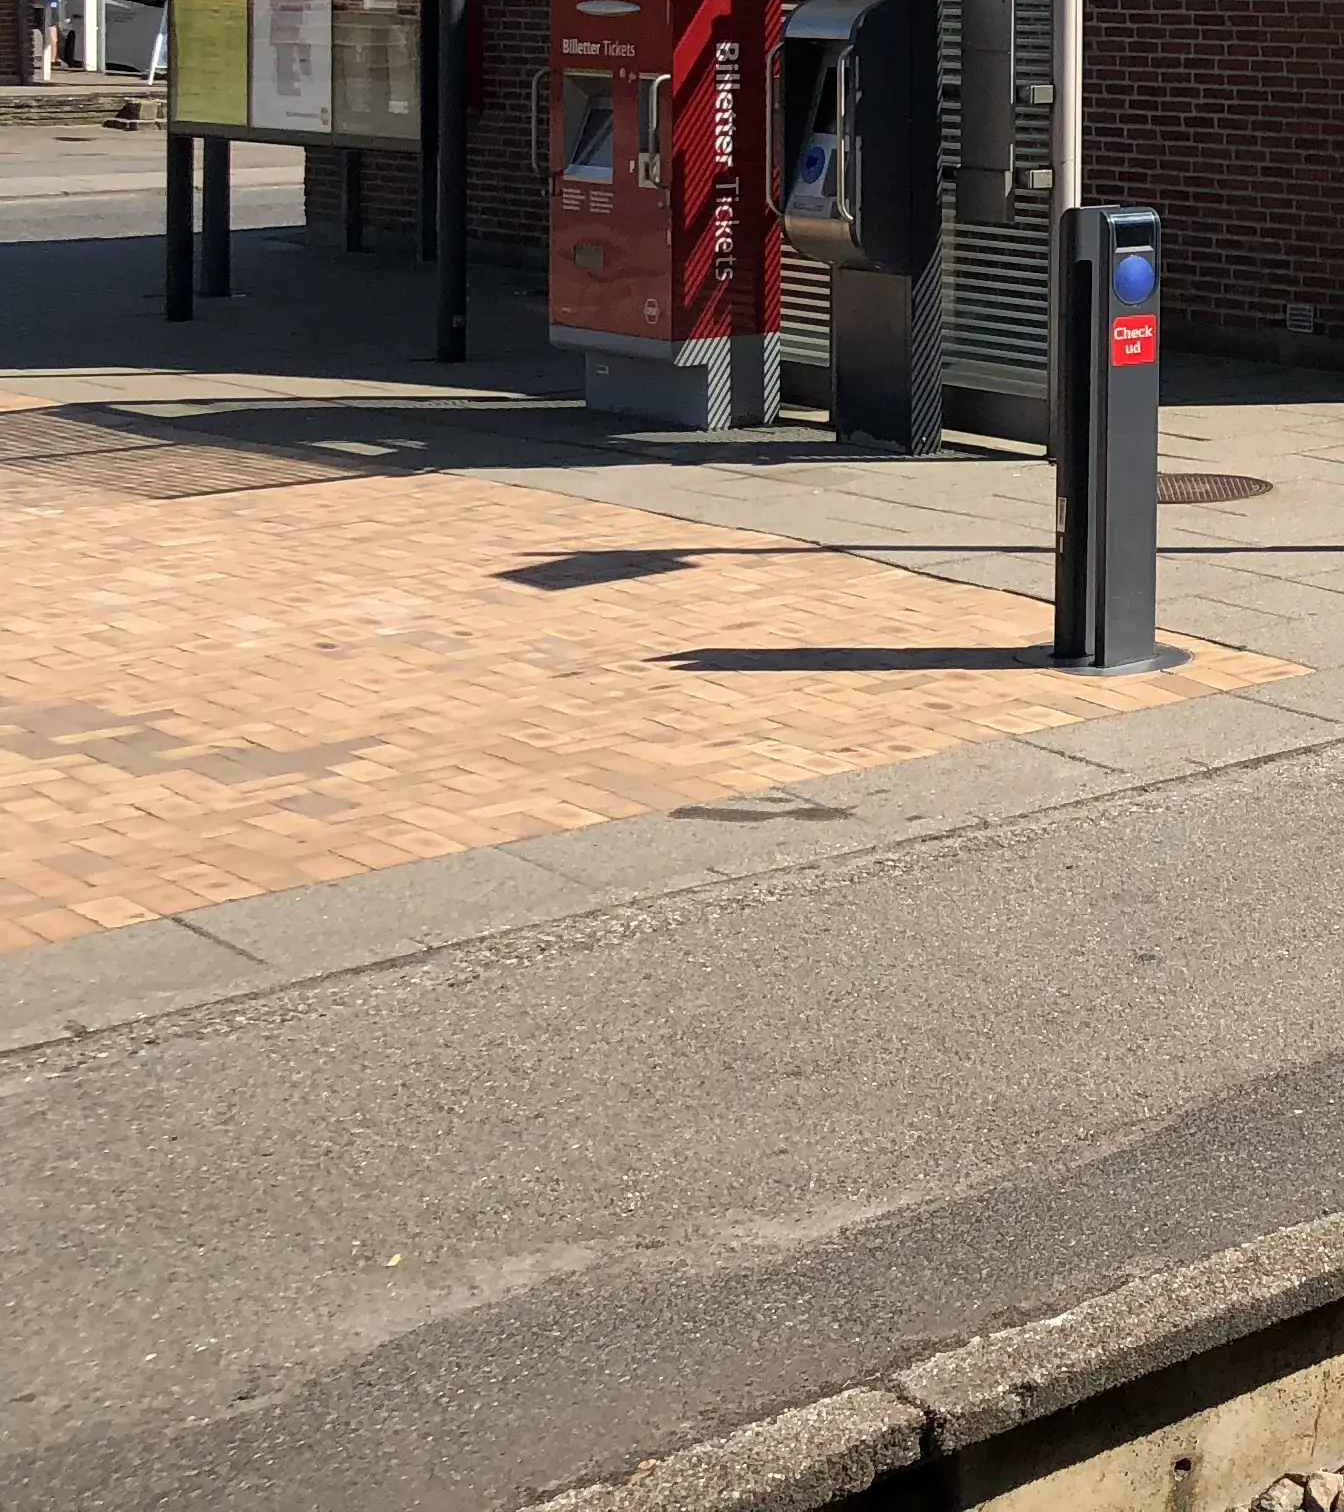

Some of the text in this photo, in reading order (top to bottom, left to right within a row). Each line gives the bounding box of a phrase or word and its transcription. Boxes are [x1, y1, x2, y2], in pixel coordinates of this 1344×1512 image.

[562, 38, 636, 57] Billetter Tickets
[715, 41, 741, 281] Billetter Tickets
[1113, 325, 1153, 340] Check
[1125, 341, 1141, 354] ud
